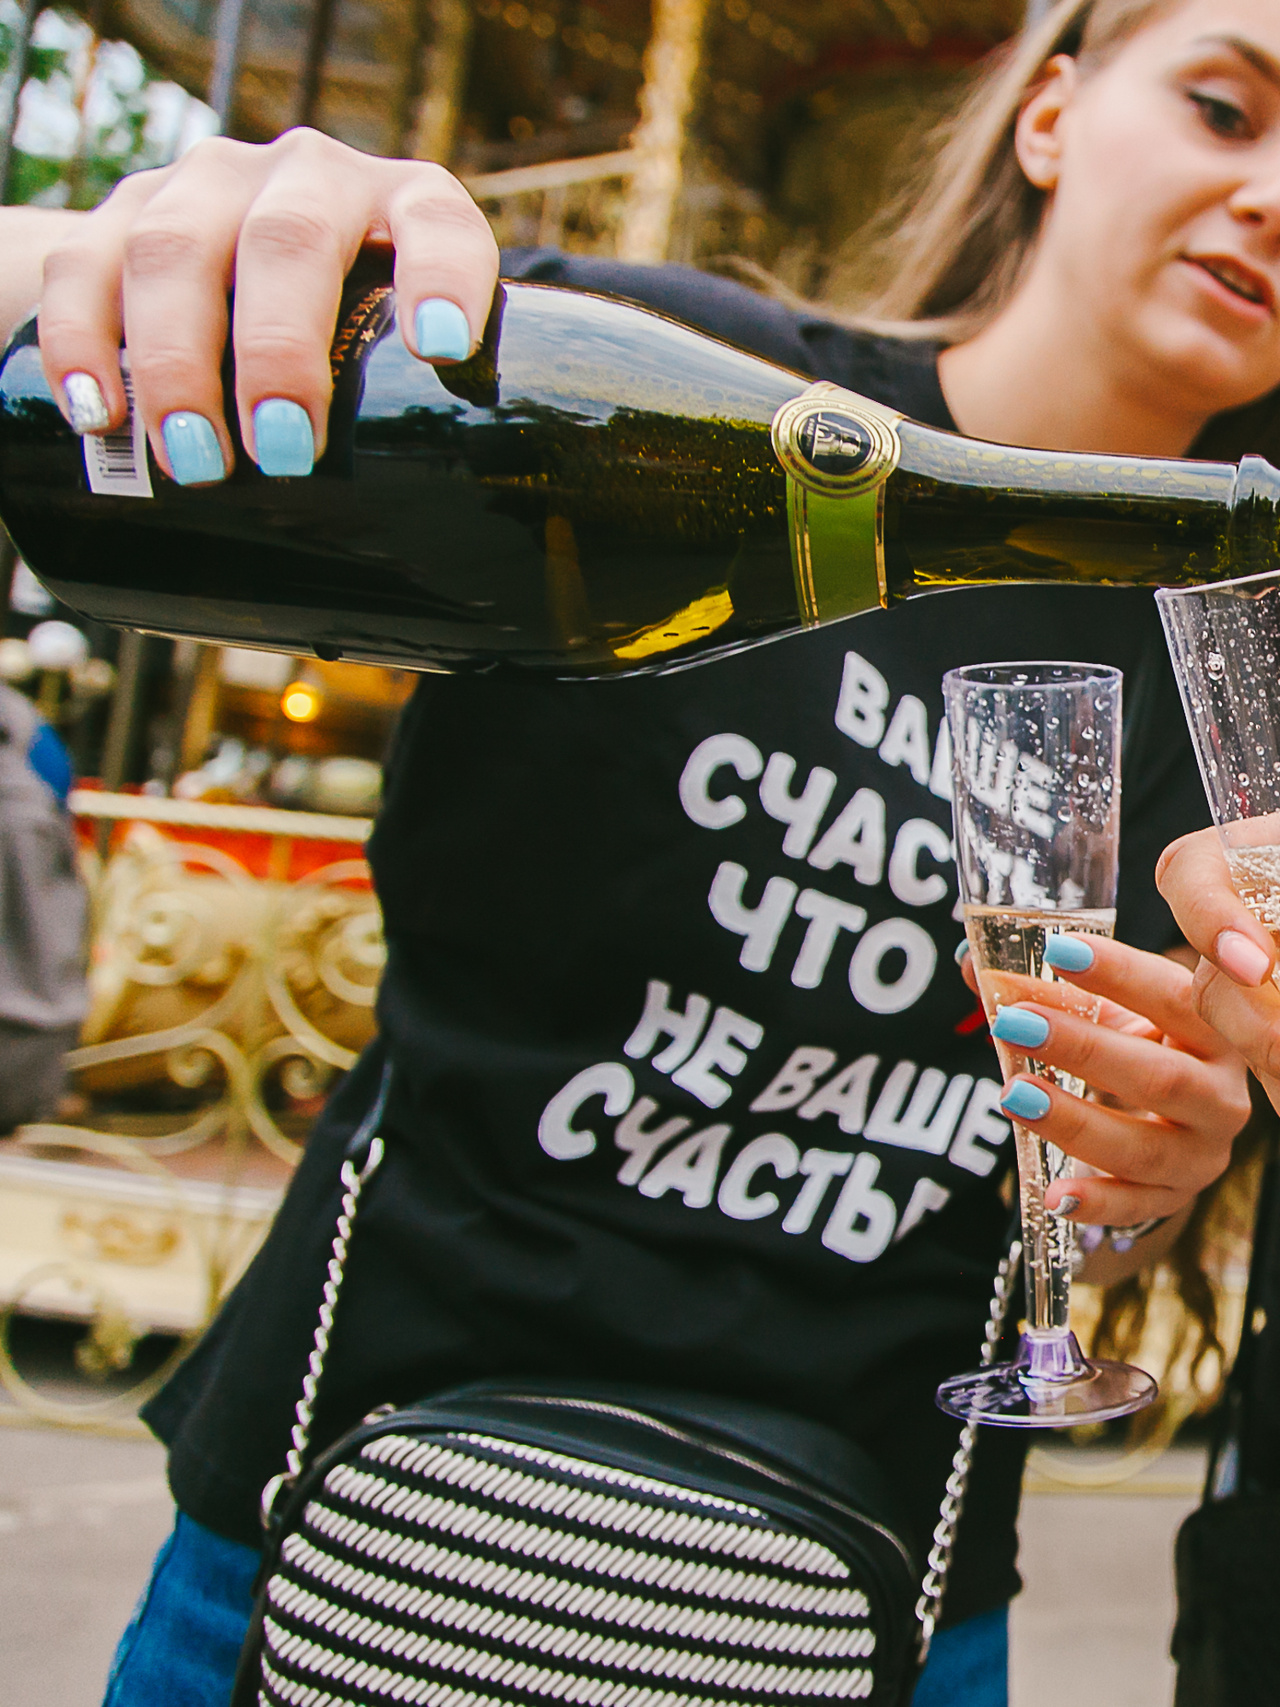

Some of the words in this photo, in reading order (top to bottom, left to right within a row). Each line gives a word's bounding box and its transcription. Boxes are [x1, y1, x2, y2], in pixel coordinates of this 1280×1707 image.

[835, 650, 1057, 839] ВАШЕ
[708, 861, 938, 1014] ЧТО
[623, 979, 764, 1108] НЕ
[750, 1045, 1011, 1177] ВАШЕ
